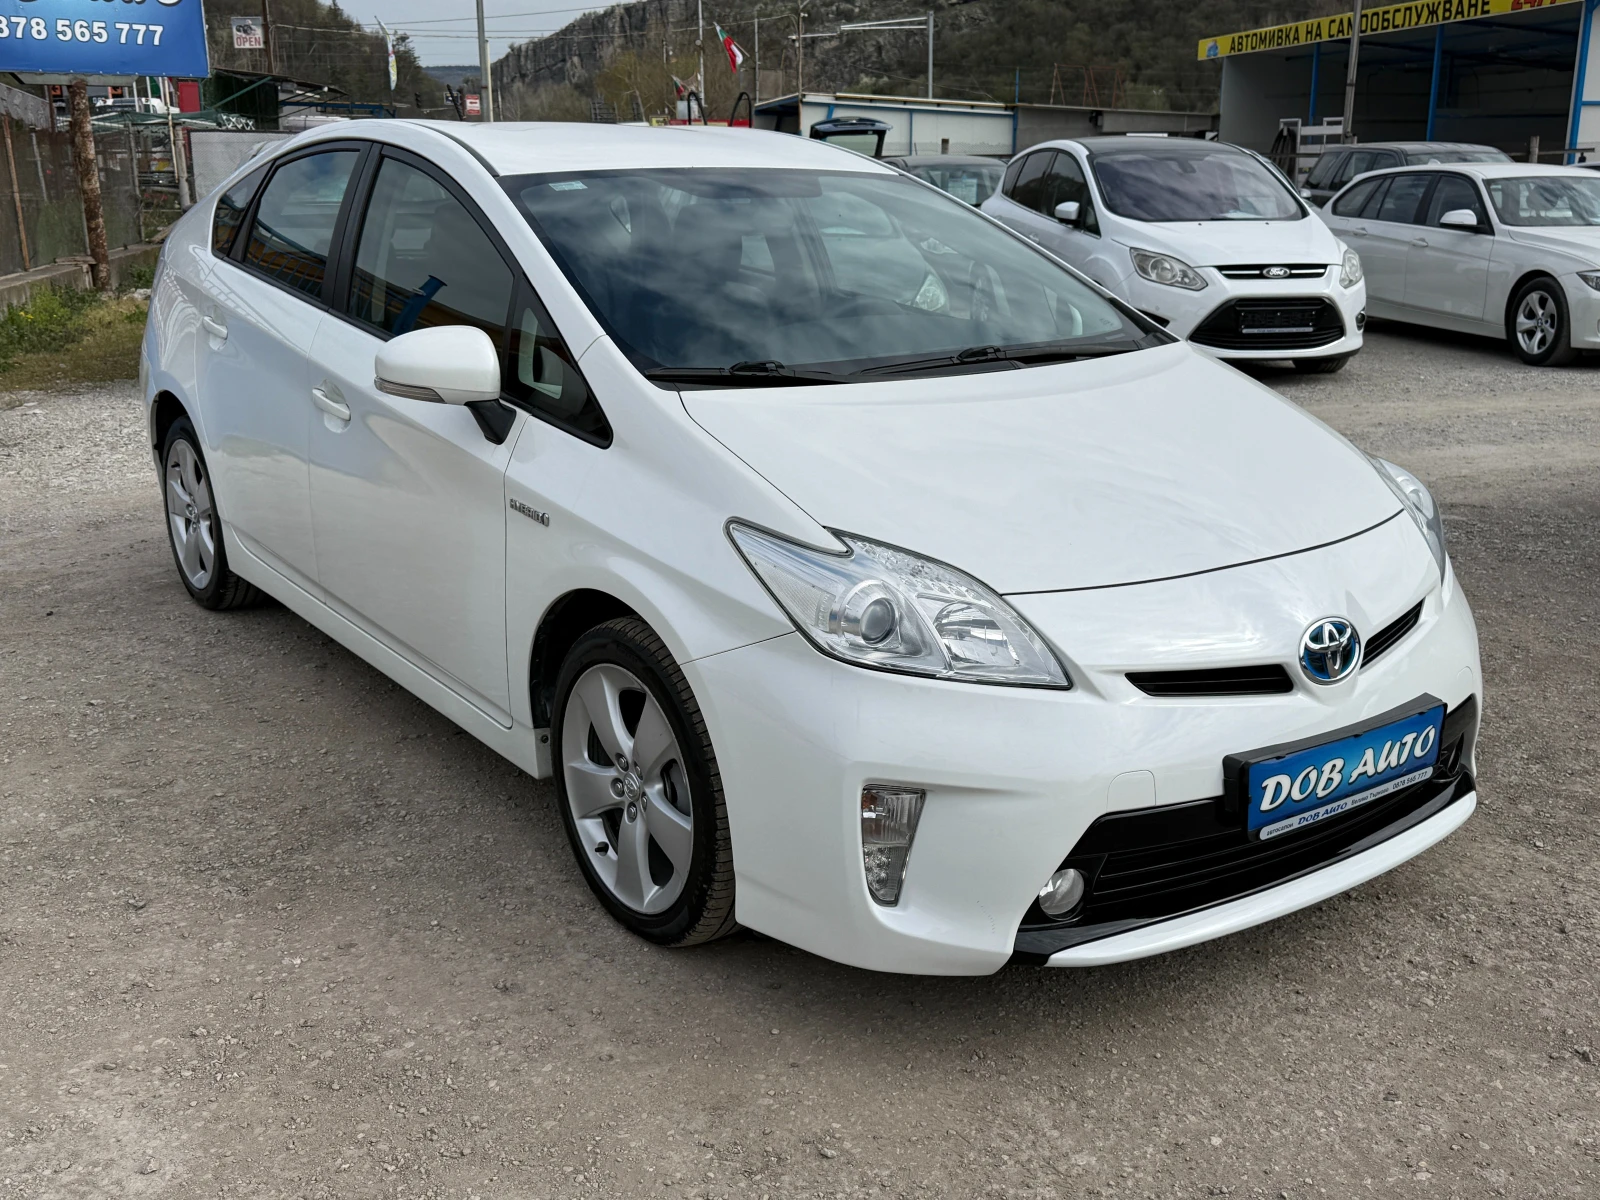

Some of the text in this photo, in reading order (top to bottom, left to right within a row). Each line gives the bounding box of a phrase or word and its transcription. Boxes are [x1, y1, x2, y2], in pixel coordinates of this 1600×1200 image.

[55, 18, 109, 44] 565
[114, 22, 165, 47] 777
[236, 36, 261, 47] OPEN
[1229, 26, 1300, 54] АВТОМИВКА
[1305, 22, 1322, 42] НА
[1259, 724, 1437, 813] DOB AUTO
[1298, 812, 1320, 825] DOB
[1321, 802, 1348, 816] AUTO
